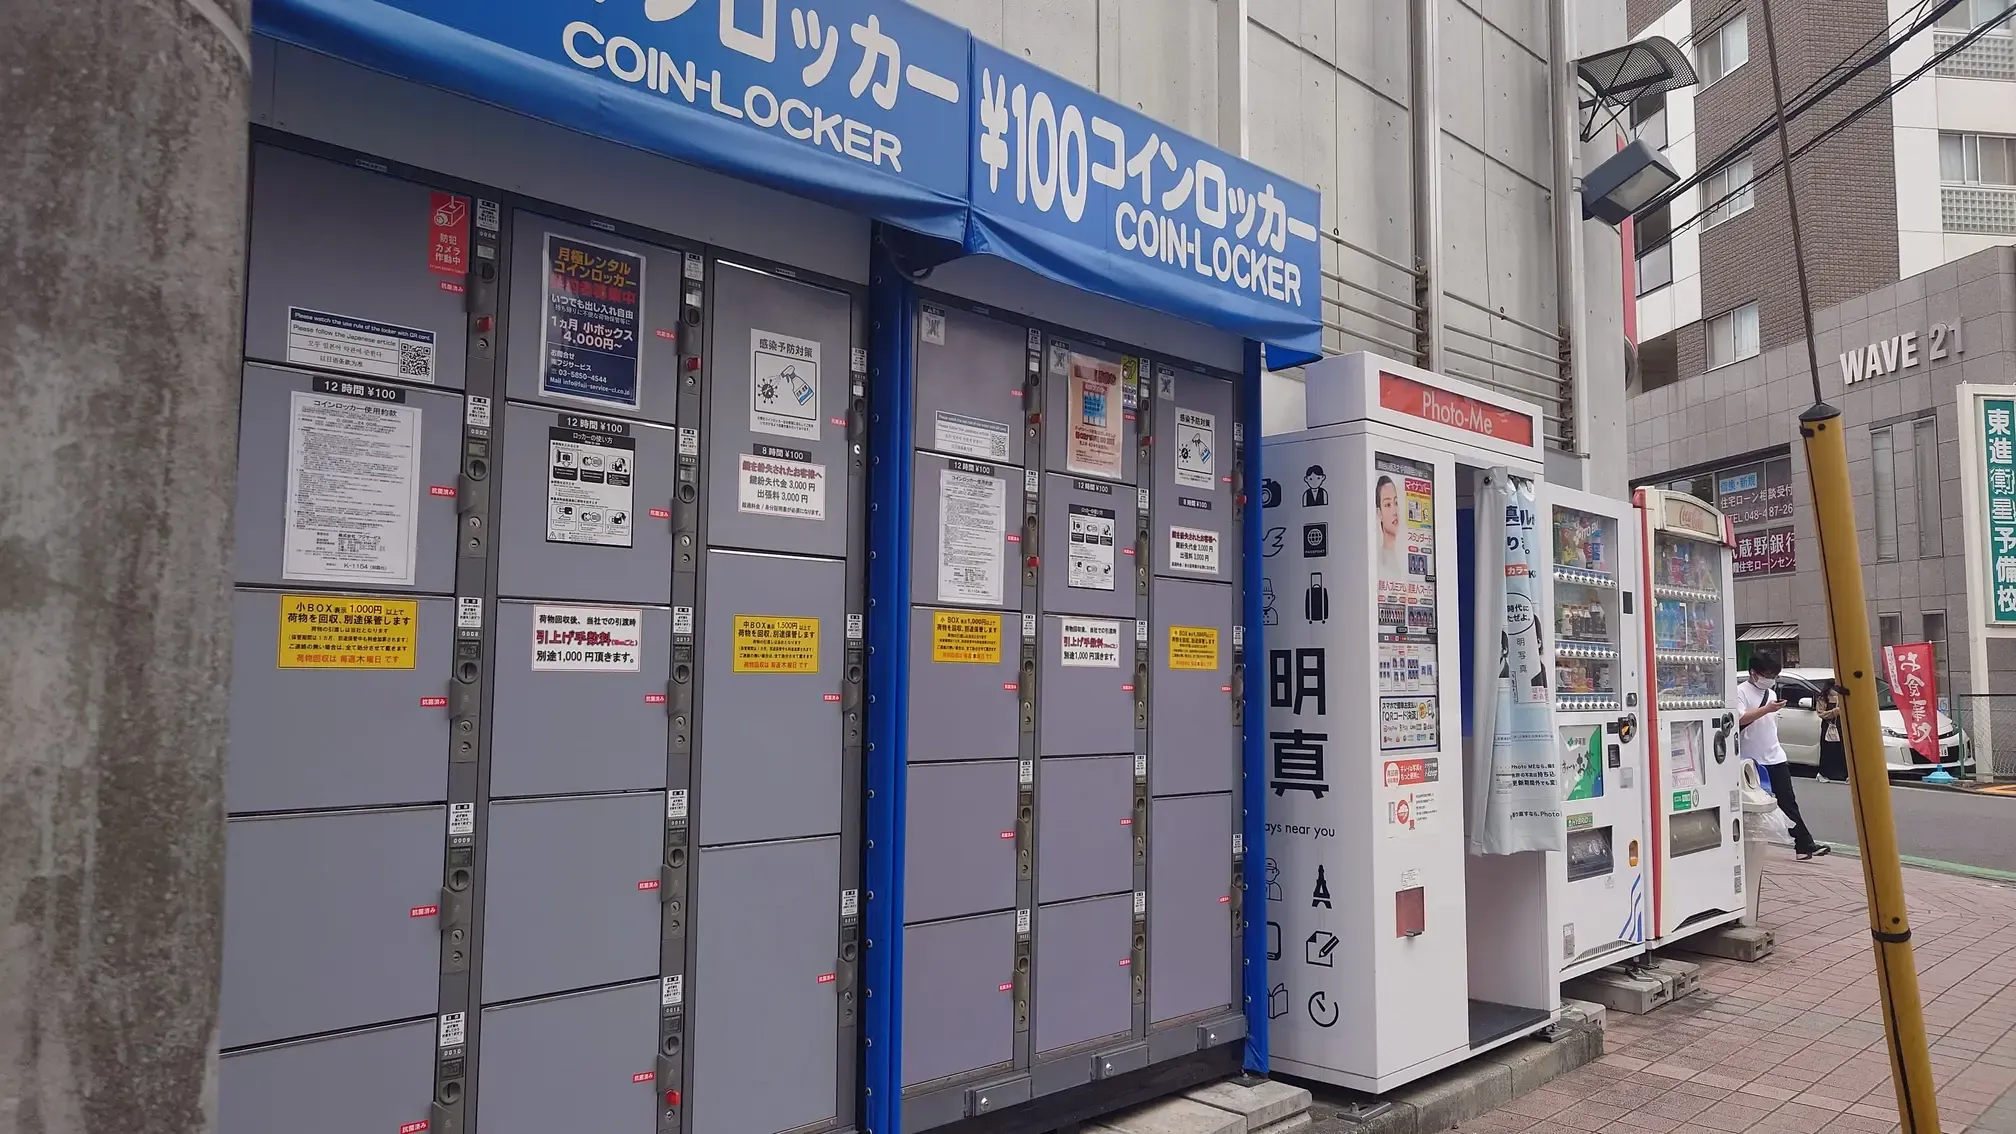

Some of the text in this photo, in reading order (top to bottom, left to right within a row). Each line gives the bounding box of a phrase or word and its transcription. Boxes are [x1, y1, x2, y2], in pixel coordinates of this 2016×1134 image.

[562, 21, 902, 172] COIN-LOCKER
[980, 67, 1317, 253] ¥100 コインロッカー
[439, 233, 457, 245] 防犯
[435, 244, 461, 255] カメラ
[435, 253, 461, 265] 作動中
[1115, 202, 1302, 307] COIN-LOCKER
[553, 260, 637, 288] コインロッカー
[551, 293, 634, 320] いつでも出し入れ自由
[294, 312, 313, 321] Please
[314, 316, 331, 324] watch
[381, 327, 397, 335] locker
[397, 329, 409, 337] with
[583, 322, 634, 342] 小ボックス
[293, 324, 396, 347] Please follow the Japanese article
[759, 338, 813, 358] 感染予防対策
[1839, 316, 1965, 385] WAVE 21
[324, 380, 396, 400] 12 時間 ¥100
[549, 376, 562, 384] Mail
[1422, 390, 1493, 435] Photo-Me
[567, 417, 623, 433] 12 時間 ¥100
[761, 447, 804, 460] 8 時間 ¥100
[954, 461, 962, 469] 12
[975, 464, 991, 474] ¥100
[757, 489, 780, 500] 出張料
[801, 494, 809, 504] 円
[808, 482, 816, 492] 円
[1077, 481, 1085, 489] 12
[1095, 484, 1109, 493] ¥100
[1720, 483, 1793, 509] 住宅ローン相談受付
[1987, 408, 2016, 613] 東進衛星予備校
[1270, 648, 1326, 716] 明
[1270, 729, 1330, 800] 真
[1285, 824, 1311, 836] near
[1314, 827, 1336, 839] you
